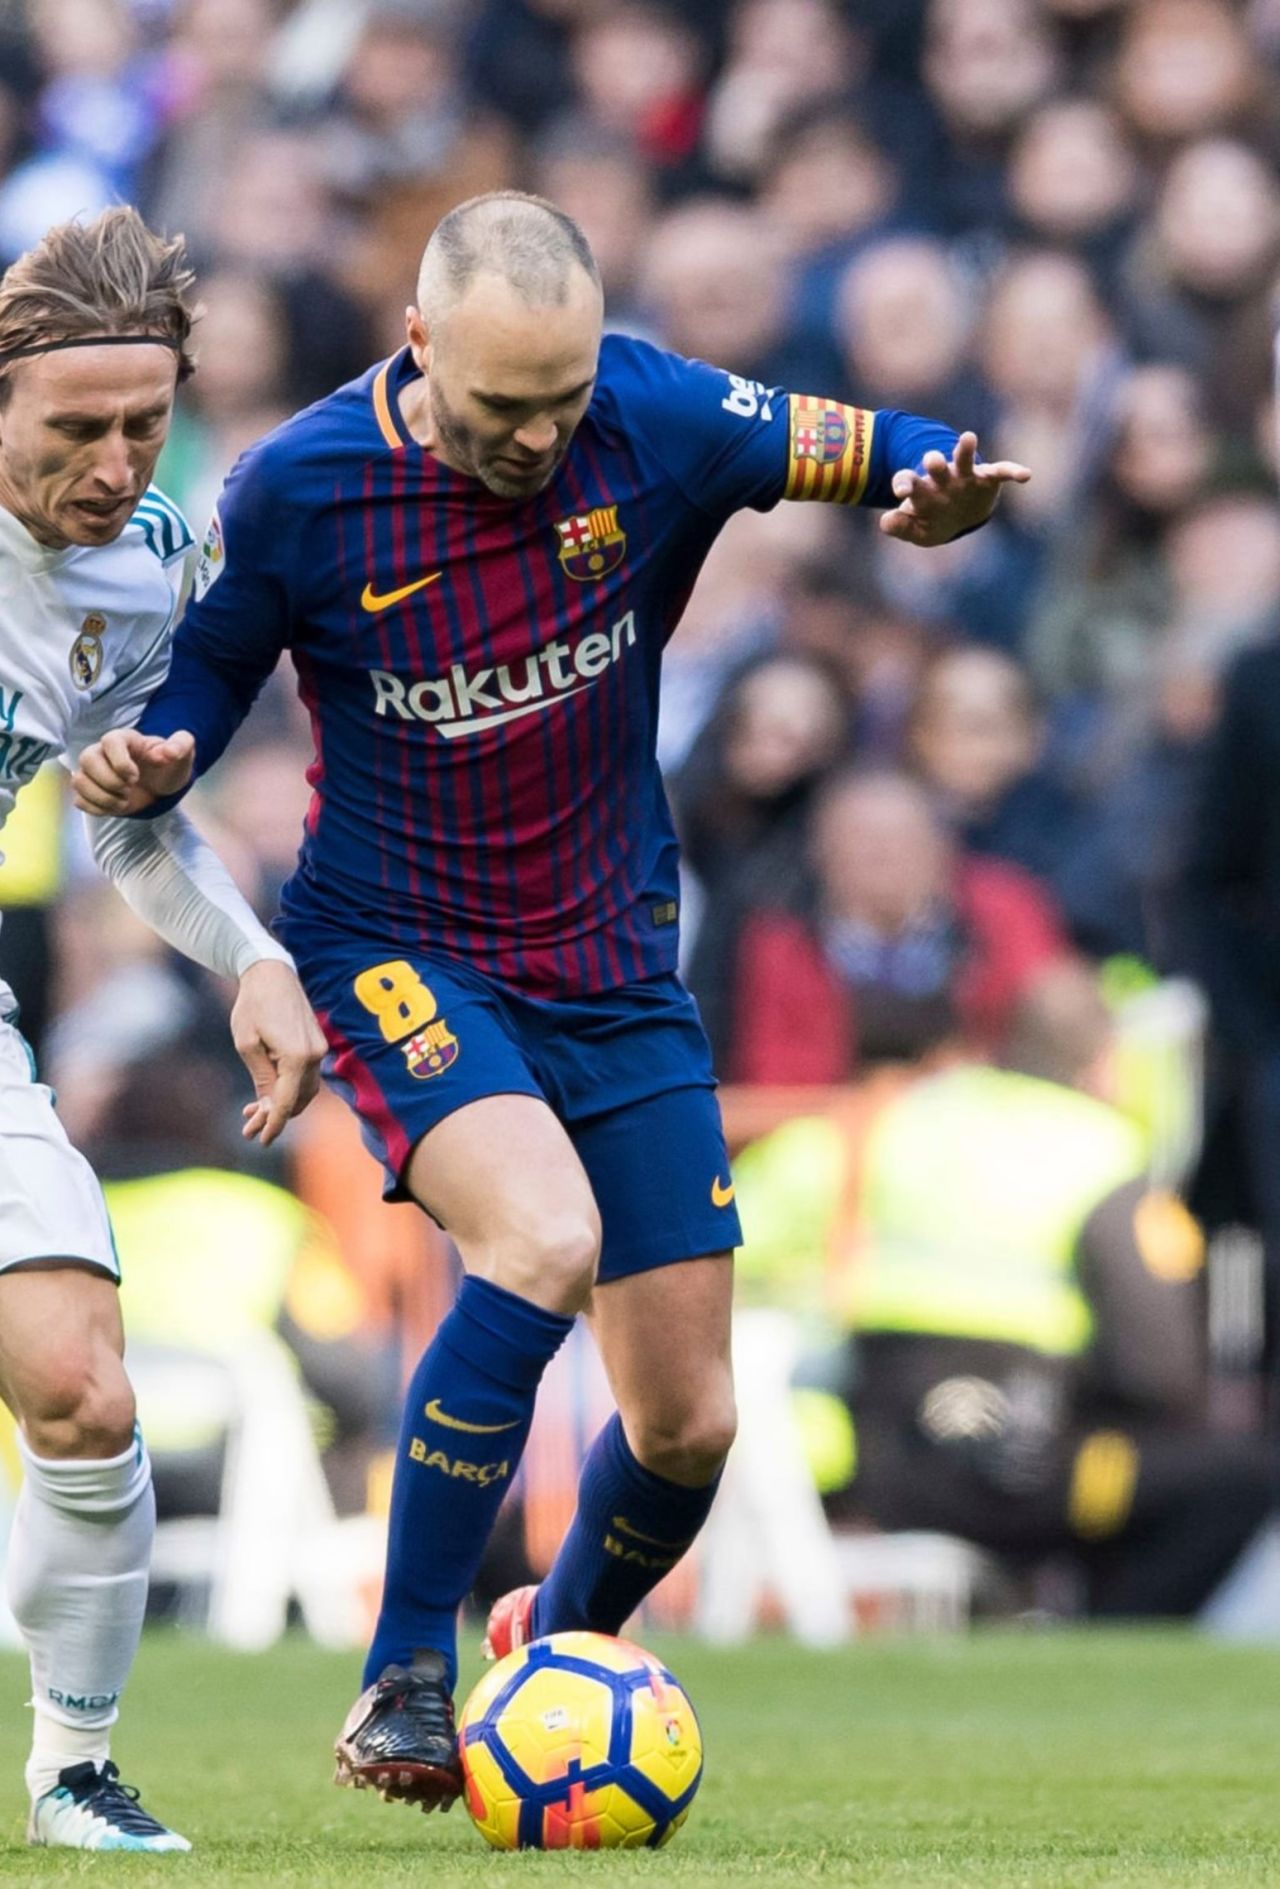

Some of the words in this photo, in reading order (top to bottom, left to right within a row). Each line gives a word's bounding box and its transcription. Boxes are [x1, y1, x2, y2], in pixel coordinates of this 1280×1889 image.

[722, 374, 766, 418] be
[369, 610, 637, 722] Rakuten
[354, 959, 437, 1044] 8
